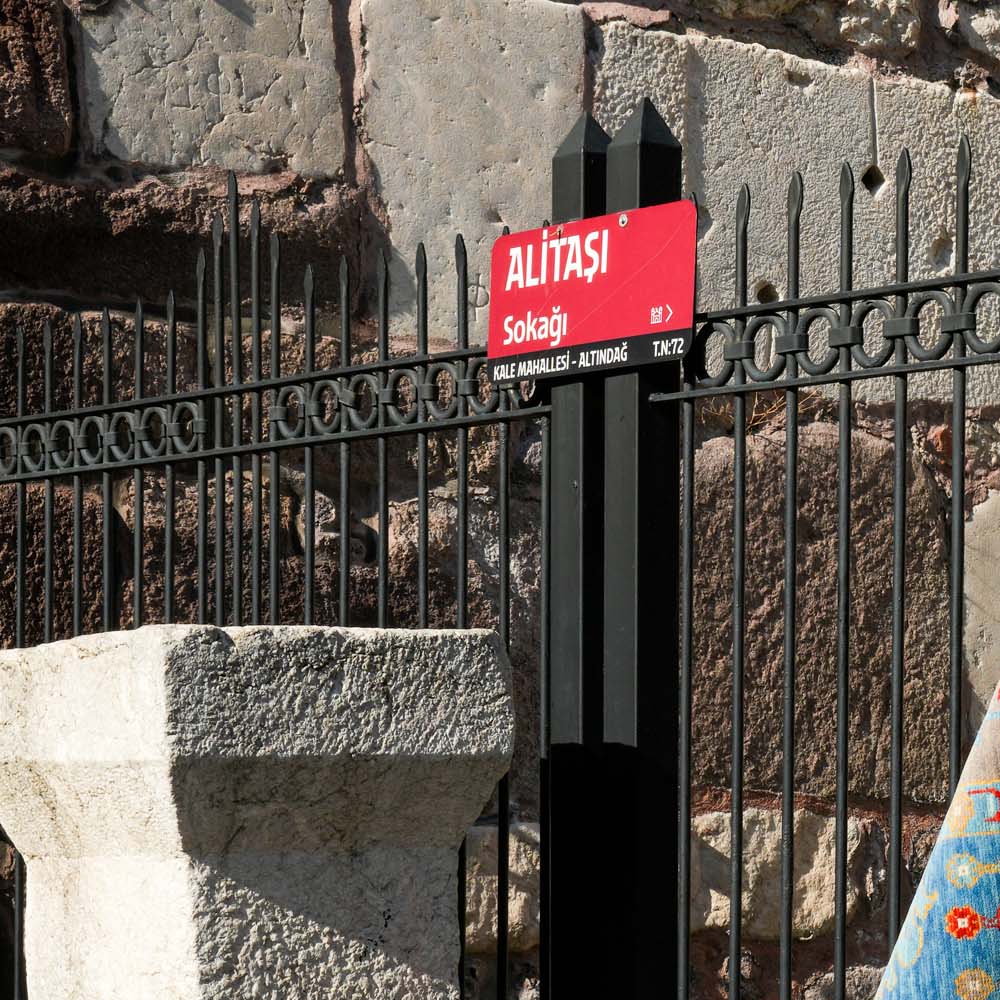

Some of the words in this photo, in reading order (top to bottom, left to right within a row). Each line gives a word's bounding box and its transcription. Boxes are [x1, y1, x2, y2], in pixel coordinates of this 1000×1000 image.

[505, 229, 609, 291] ALİTAŞI
[503, 306, 567, 346] Sokağı
[493, 363, 515, 381] KALE
[517, 351, 569, 377] MAHALLESİ
[578, 343, 628, 368] ALTINDAĞ
[653, 337, 684, 357] T.N:72
